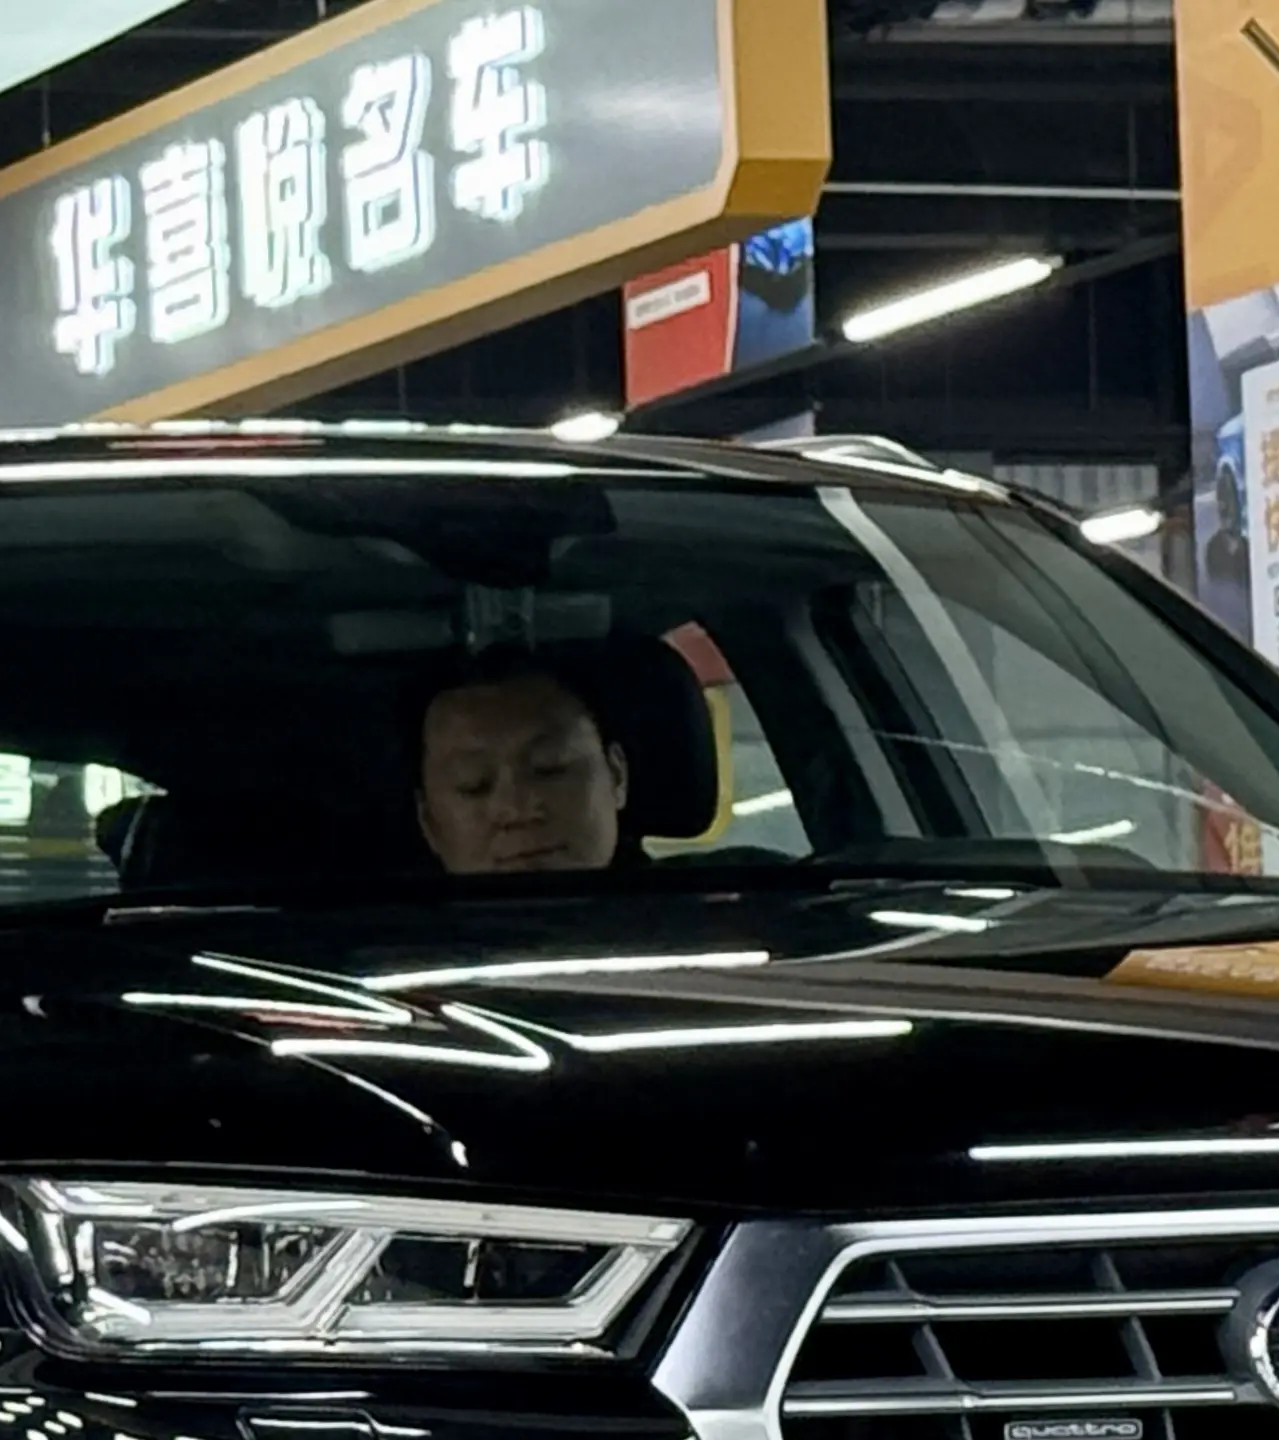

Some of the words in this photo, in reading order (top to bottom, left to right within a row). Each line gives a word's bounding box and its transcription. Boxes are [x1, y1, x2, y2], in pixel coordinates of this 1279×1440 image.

[50, 8, 552, 377] 华喜悦名车
[1011, 1422, 1137, 1440] quattro
